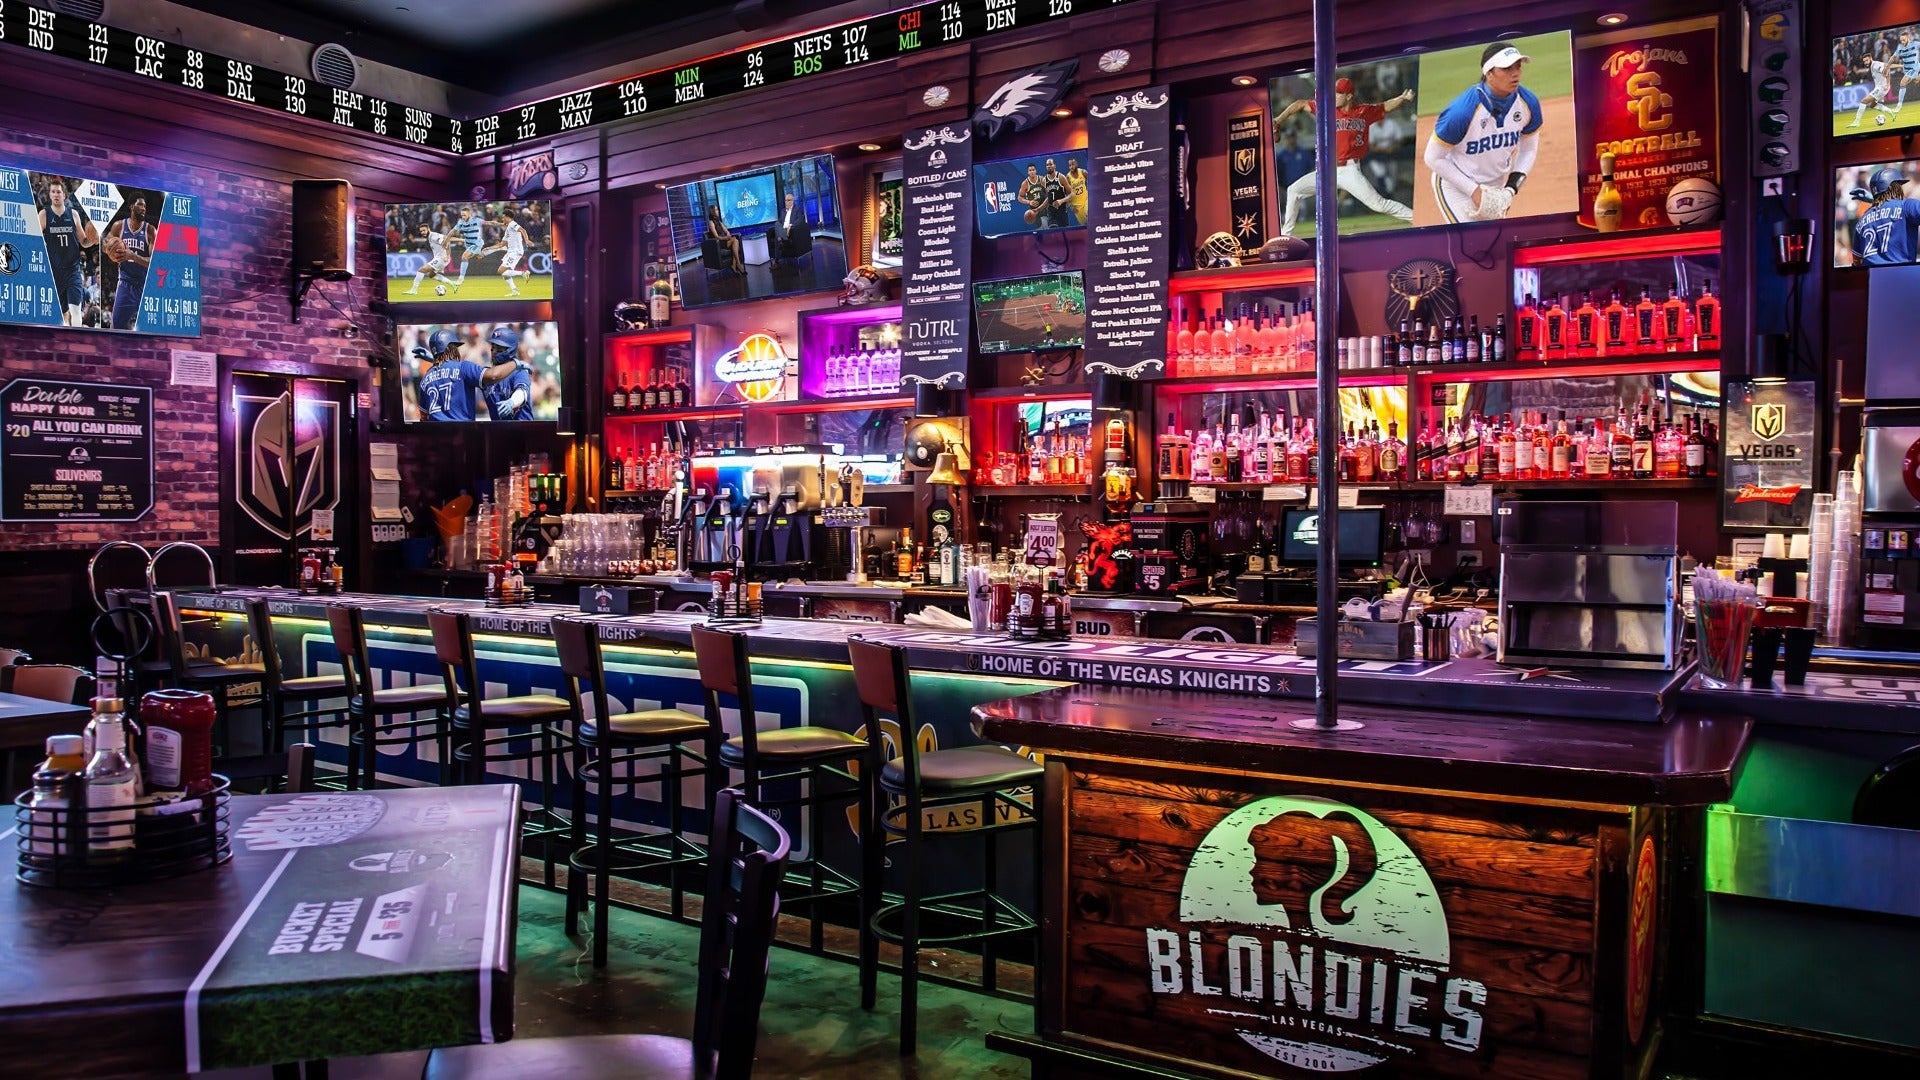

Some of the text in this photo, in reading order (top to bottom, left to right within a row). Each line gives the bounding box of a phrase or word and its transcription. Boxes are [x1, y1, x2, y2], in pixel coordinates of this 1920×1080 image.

[898, 3, 962, 32] CHI 114
[986, 0, 1073, 32] DEN 126
[28, 7, 56, 31] DET
[88, 24, 109, 45] 121
[793, 25, 869, 58] NETS 107
[898, 21, 964, 51] MIL 110
[28, 28, 108, 65] IND 117
[135, 36, 204, 70] OKC 88
[793, 45, 871, 77] BOS 114
[1601, 45, 1689, 78] Trojans
[135, 55, 204, 90] LAC 138
[227, 60, 306, 96] SAS 120
[674, 53, 764, 87] MIN 96
[674, 71, 765, 104] MEM 124
[227, 80, 307, 115] DAL 130
[332, 88, 388, 118] HEAT 116
[558, 80, 645, 114] JAZZ 104
[332, 108, 387, 136] ATL 86
[404, 107, 462, 136] SUNS 72
[475, 106, 536, 134] TOR 97
[559, 97, 648, 131] MAV 110
[405, 125, 463, 153] NOP 84
[475, 123, 537, 150] PHI 112
[1115, 141, 1144, 153] DRAFT
[1595, 131, 1702, 160] FOOTBALL
[1104, 160, 1154, 173] Michelob Ultra
[1588, 160, 1709, 184] NAONAL CHAMPIONS
[907, 169, 968, 185] BOTTLED CANS
[1112, 173, 1146, 184] Bud Light
[96, 183, 110, 198] NBA
[997, 181, 1008, 194] NBA
[1111, 186, 1147, 196] Budweiser
[1234, 185, 1259, 197] VEGAS
[912, 192, 962, 204] Michelob Ultra
[998, 191, 1016, 204] League
[1103, 201, 1122, 209] Kona
[1122, 198, 1135, 207] Big
[4, 203, 22, 218] LUKA
[173, 197, 192, 216] EAST
[921, 203, 954, 214] Bud Light
[1000, 203, 1012, 214] Pass
[1109, 209, 1149, 220] Mango Cart
[90, 209, 102, 222] WEEK
[919, 215, 955, 225] Budweiser
[938, 225, 956, 235] Light
[1095, 220, 1162, 233] Golden Road Brown
[57, 234, 69, 247] 77
[924, 237, 950, 247] Modelo
[1094, 231, 1162, 245] Golden Road Blonde
[1861, 221, 1893, 258] 27
[921, 249, 953, 258] Guinness
[1107, 245, 1150, 256] Stella Artois
[919, 259, 954, 269] Miller Lite
[1103, 257, 1153, 268] Estrella Jalisco
[911, 268, 961, 281] Angry Orchard
[1109, 270, 1147, 280] Shock Top
[906, 282, 965, 295] Bud Light Seltzer
[1091, 316, 1162, 329] Four Peaks Kilt Lifter
[1097, 329, 1155, 340] Bud Light Seltzer
[450, 368, 461, 381] JR.
[23, 386, 86, 404] Double
[427, 381, 453, 415] 27
[11, 402, 55, 414] HAPPY
[58, 405, 96, 416] HOUR
[6, 424, 30, 438] $20
[32, 420, 143, 436] ALL YOU CAN DRINK
[1632, 440, 1648, 464] 7
[1740, 444, 1796, 458] VEGAS
[55, 469, 103, 482] SOUVENIRS
[1739, 485, 1797, 501] Budweiser
[1110, 549, 1133, 560] FIREBALL
[1141, 565, 1166, 577] SHOTS
[1143, 575, 1161, 590] $5
[268, 602, 294, 614] NIGHTS
[480, 616, 509, 632] HOME
[511, 618, 525, 633] OF
[527, 620, 547, 634] THE
[1075, 620, 1111, 636] BUD
[600, 626, 637, 642] IGHTS
[982, 655, 1272, 694] HOME OF THE VEGAS KNIGHTS
[926, 807, 979, 830] LAS
[377, 900, 413, 921] $35
[267, 902, 327, 955] BUCKET
[308, 897, 364, 953] SPECIAL
[370, 931, 404, 942] 5
[1146, 927, 1488, 1053] BLONDIES
[1271, 1015, 1343, 1037] LAS VEGAS
[1274, 1049, 1337, 1071] EST 2004
